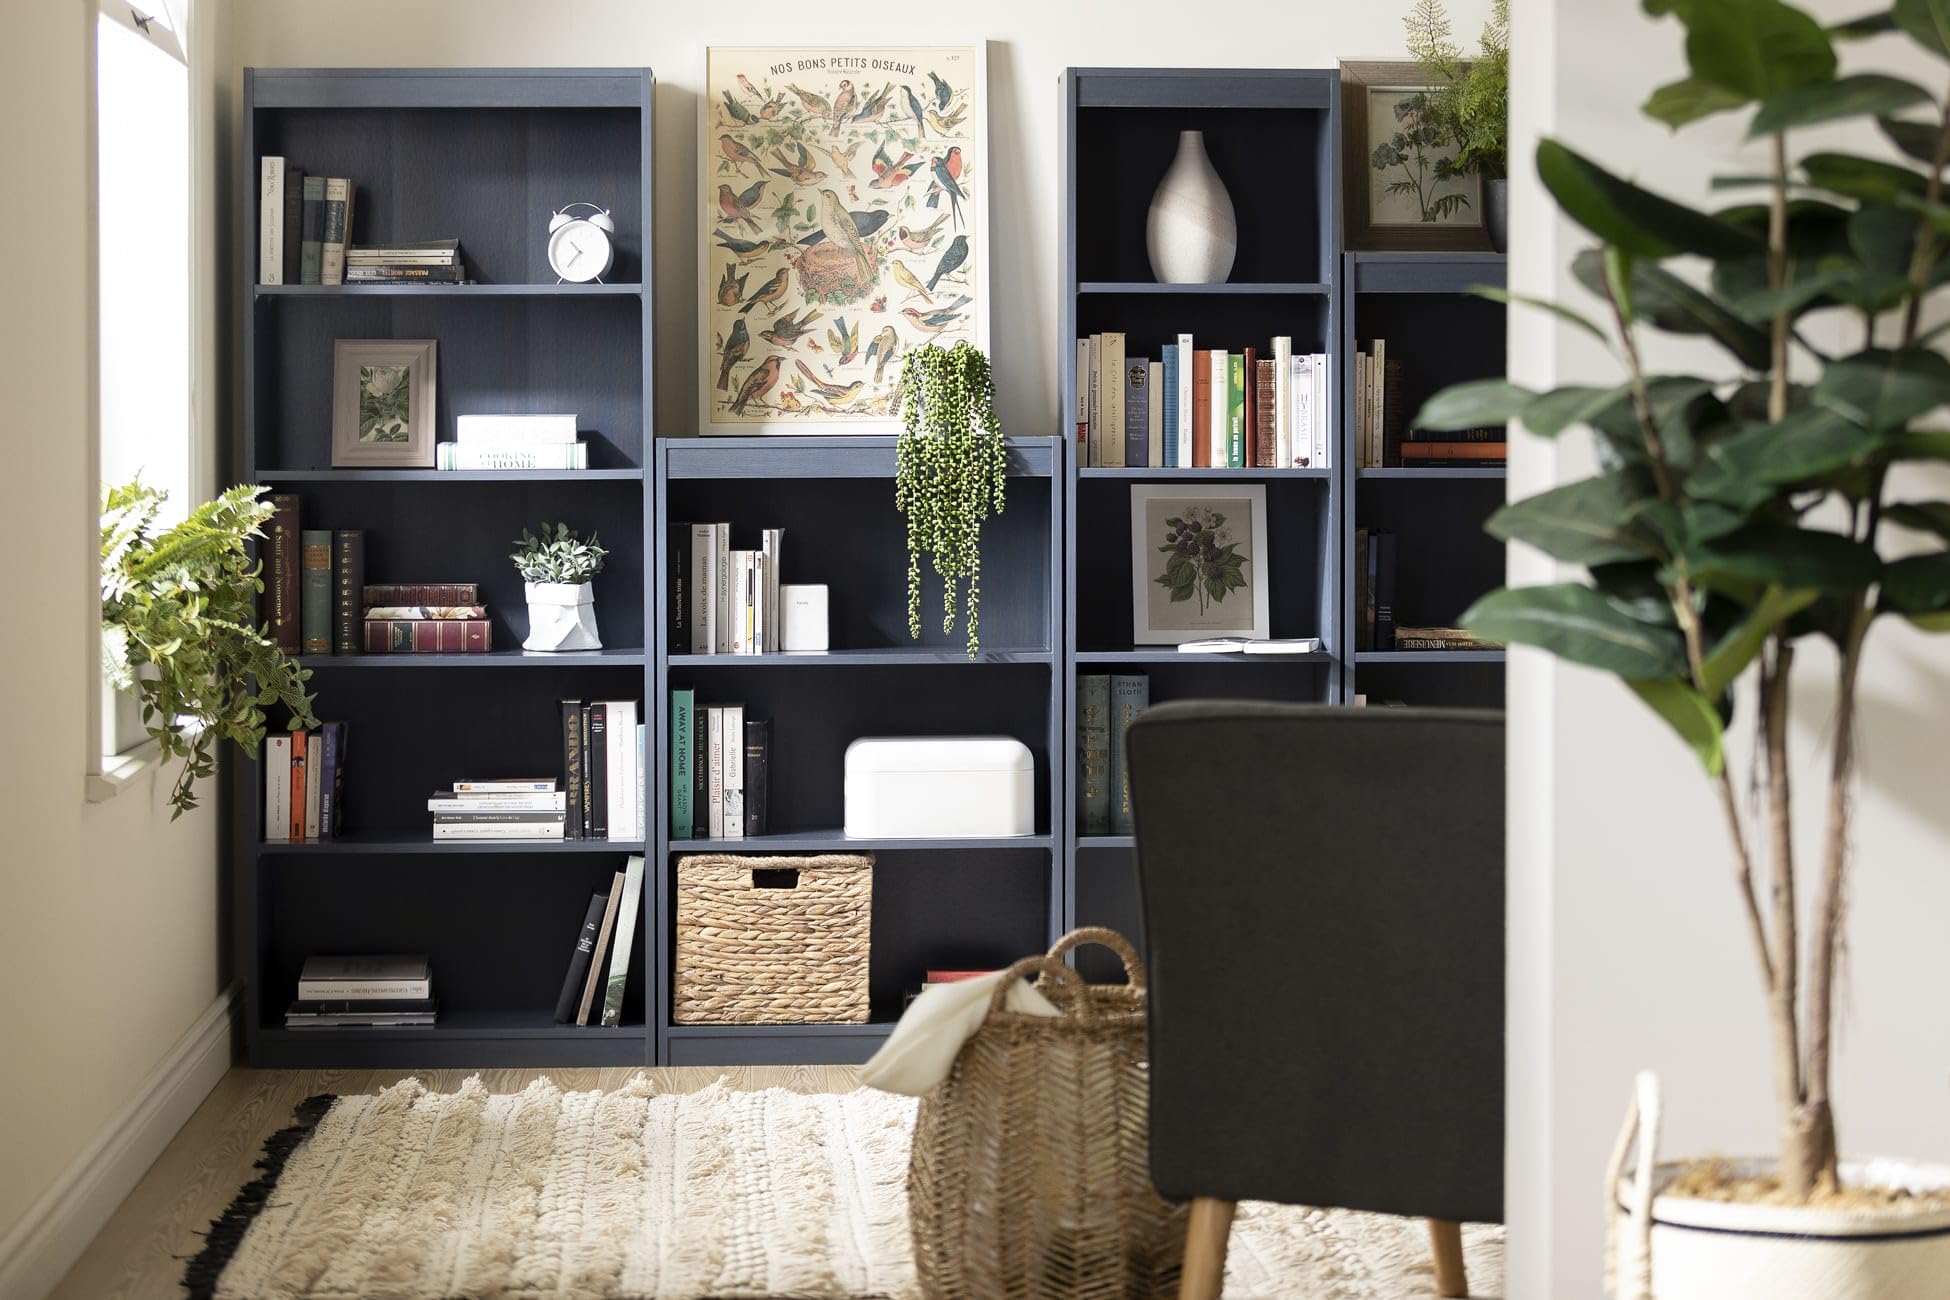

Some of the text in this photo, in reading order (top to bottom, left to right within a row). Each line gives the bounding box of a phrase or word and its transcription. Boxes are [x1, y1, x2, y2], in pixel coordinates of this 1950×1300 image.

[769, 57, 916, 76] NOS BONS PETITS OISEAUX
[479, 452, 536, 460] COOKING
[492, 460, 536, 468] HOME
[274, 535, 284, 617] Stuff and Nonsense
[719, 556, 727, 596] synergologie
[700, 586, 707, 596] de
[700, 616, 707, 627] La
[1403, 639, 1446, 648] MENUISERIE
[678, 706, 686, 777] AWAY AT HOME
[567, 714, 580, 806] BRANDO
[711, 742, 720, 775] d'aimer
[729, 747, 737, 778] Gabrielle
[583, 780, 591, 813] VAMPIRES
[682, 784, 688, 793] MR
[711, 776, 721, 804] Plaisir
